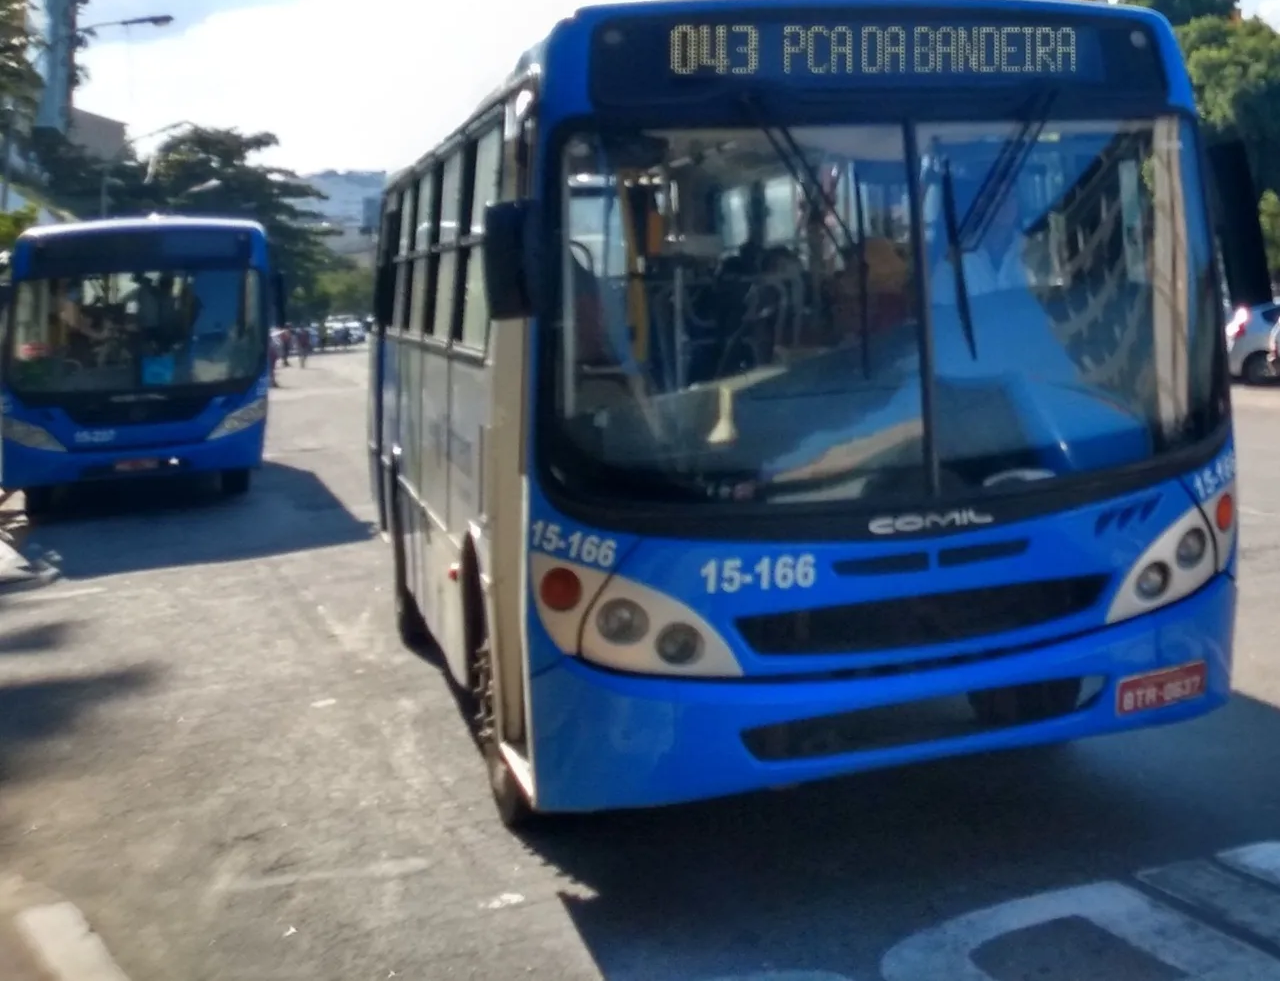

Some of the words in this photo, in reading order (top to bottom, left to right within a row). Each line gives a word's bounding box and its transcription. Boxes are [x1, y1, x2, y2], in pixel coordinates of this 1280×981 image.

[669, 24, 760, 76] 043
[783, 25, 853, 74] PCA
[861, 25, 906, 74] DA
[913, 25, 1077, 74] BANDEIRA
[531, 520, 619, 568] 15-166
[867, 508, 995, 536] COMIL
[700, 553, 817, 595] 15-166
